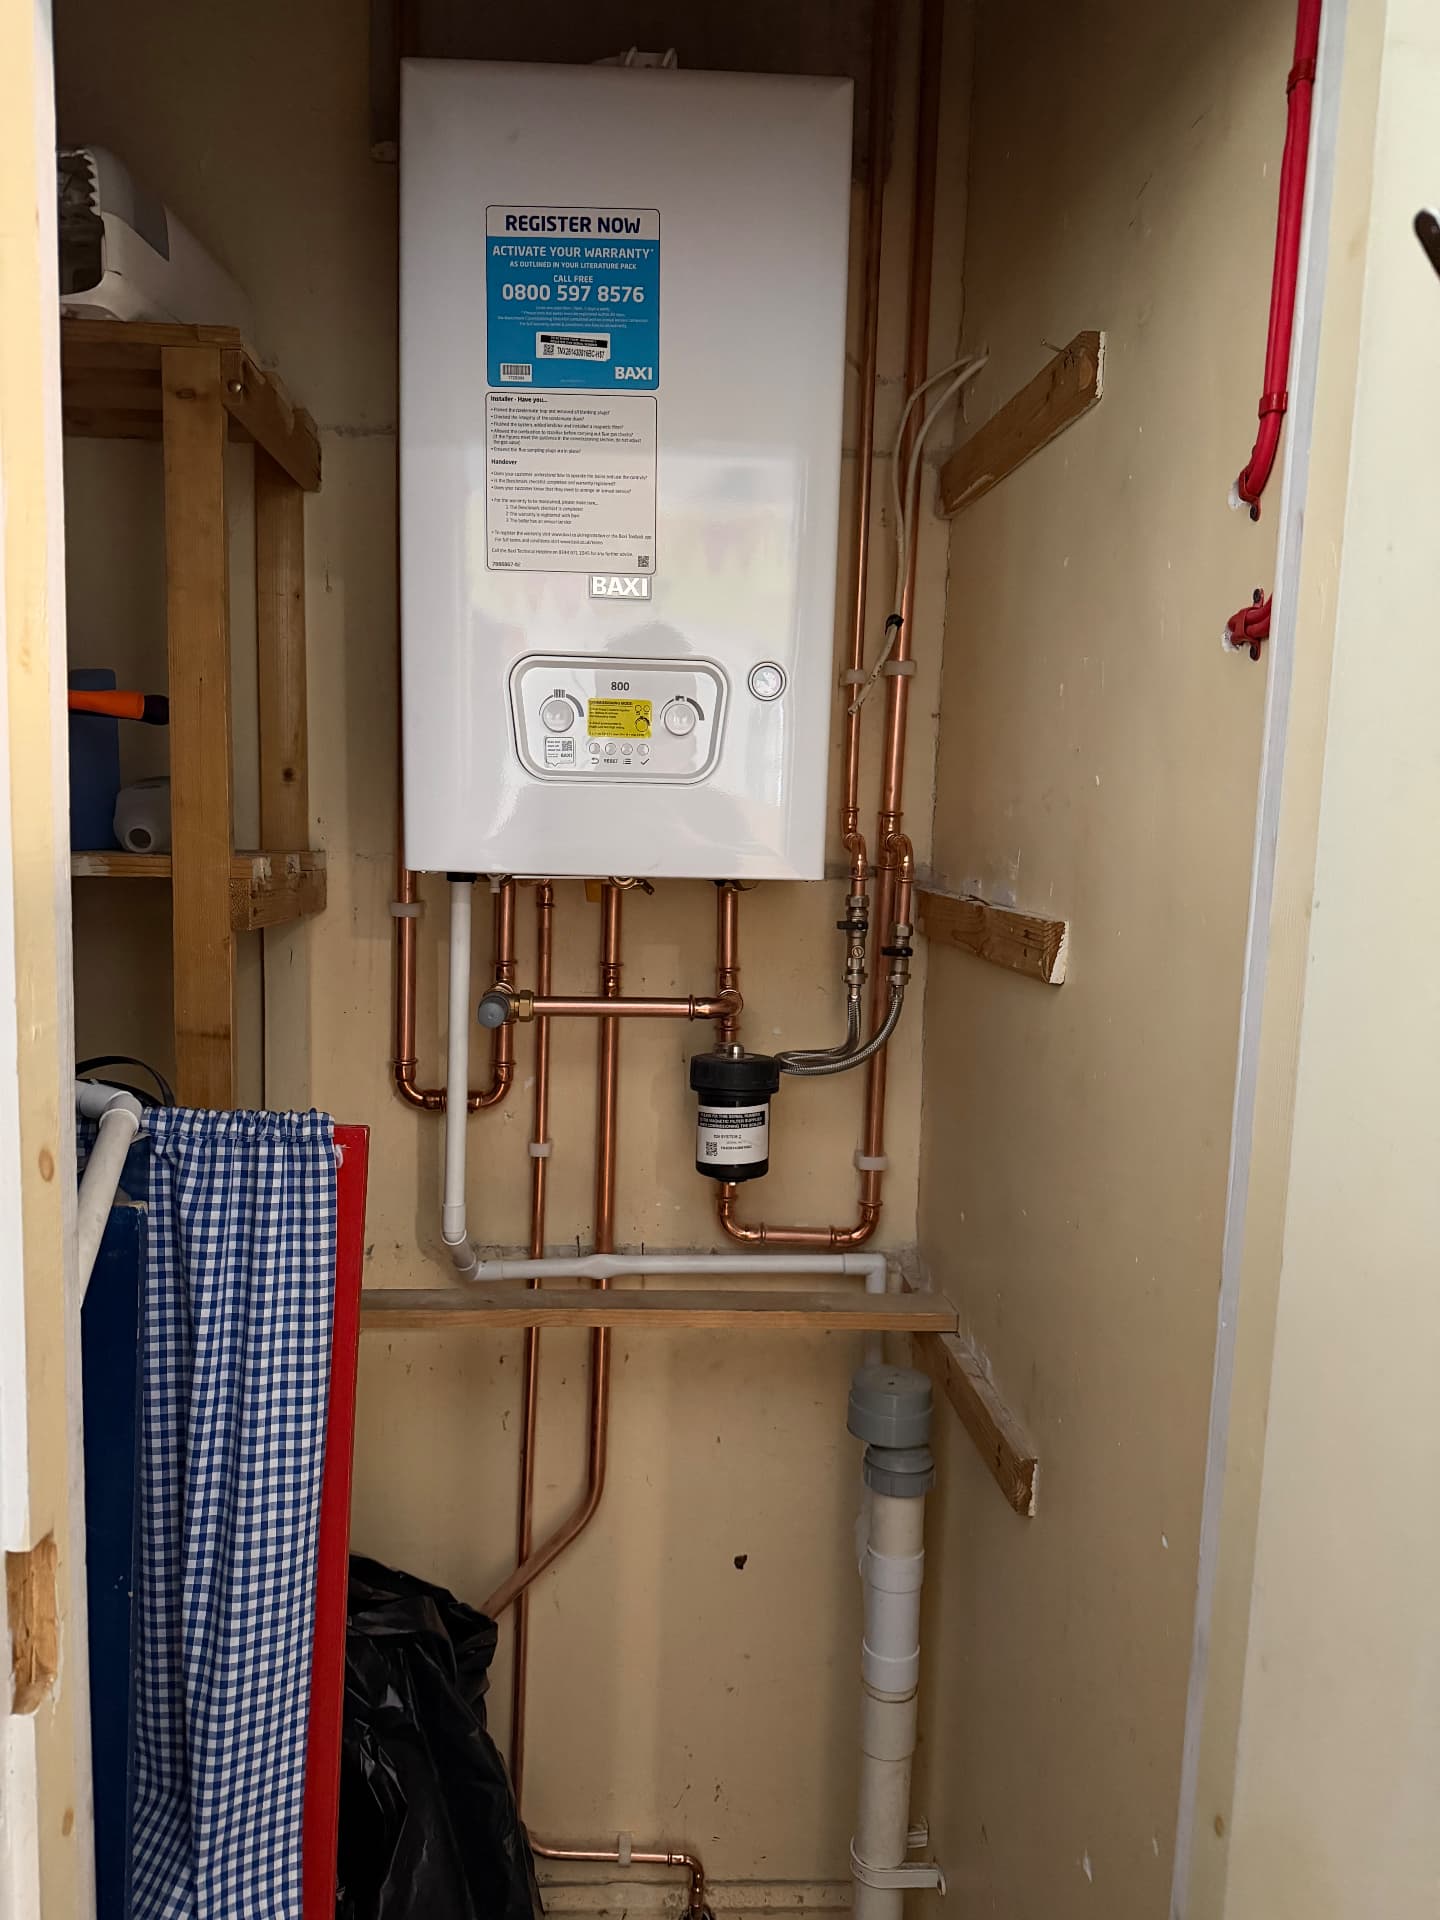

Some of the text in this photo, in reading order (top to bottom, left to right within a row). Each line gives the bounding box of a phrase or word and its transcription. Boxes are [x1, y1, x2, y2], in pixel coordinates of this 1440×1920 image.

[506, 215, 640, 233] REGISTER NOW
[493, 245, 546, 256] ACTIVATE
[551, 247, 581, 257] YOUR
[574, 275, 593, 283] FREE
[502, 284, 644, 303] 0800 597 8576
[615, 366, 652, 380] BAXI
[592, 576, 648, 597] BAXI
[611, 682, 630, 691] 800
